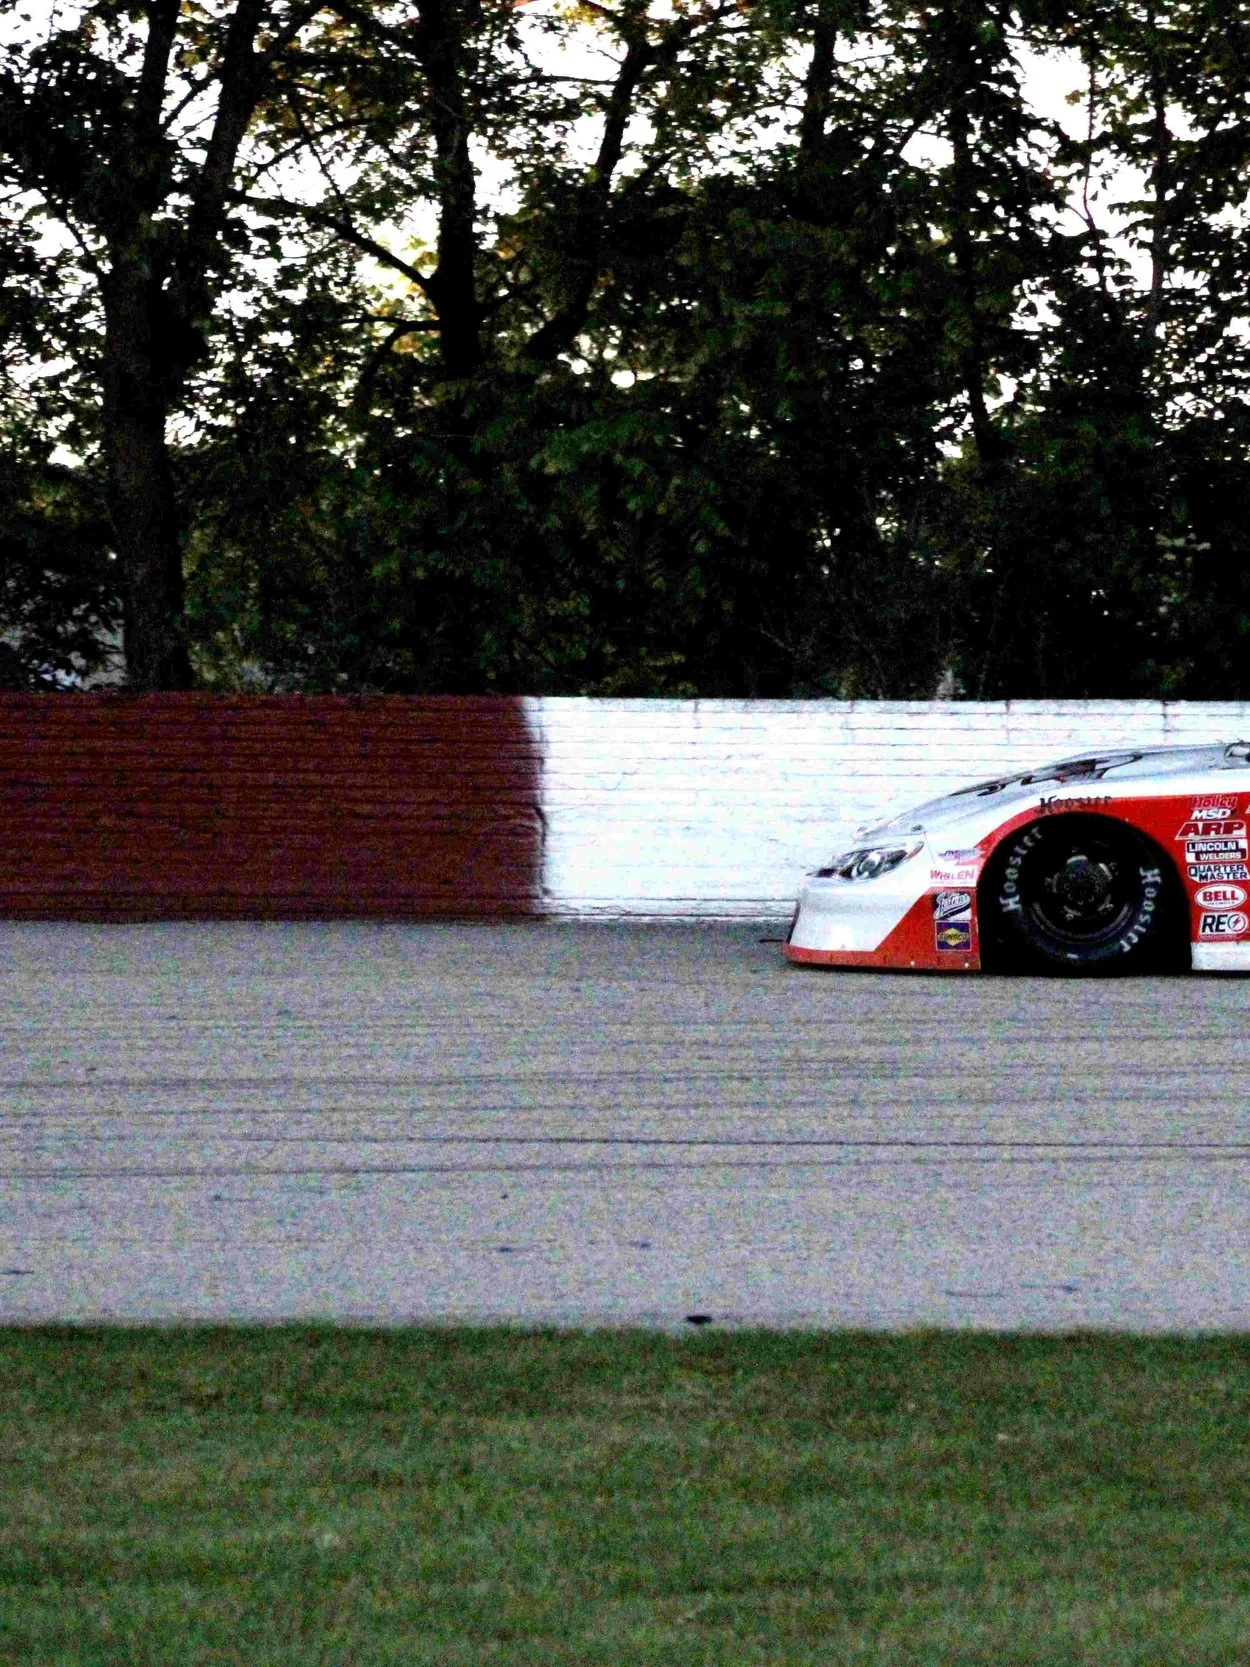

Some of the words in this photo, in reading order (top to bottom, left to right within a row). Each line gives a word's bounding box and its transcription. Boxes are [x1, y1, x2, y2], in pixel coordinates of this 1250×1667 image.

[1190, 808, 1233, 820] MSD
[1178, 821, 1245, 837] ARP
[1188, 841, 1237, 852] LINCOLN
[1200, 851, 1242, 860] WELDERS
[1000, 826, 1043, 913] Hoosier
[1188, 863, 1245, 878] QUARTER
[1199, 871, 1248, 882] MASTER
[1202, 890, 1239, 901] BELL
[1119, 866, 1163, 953] Hoosier
